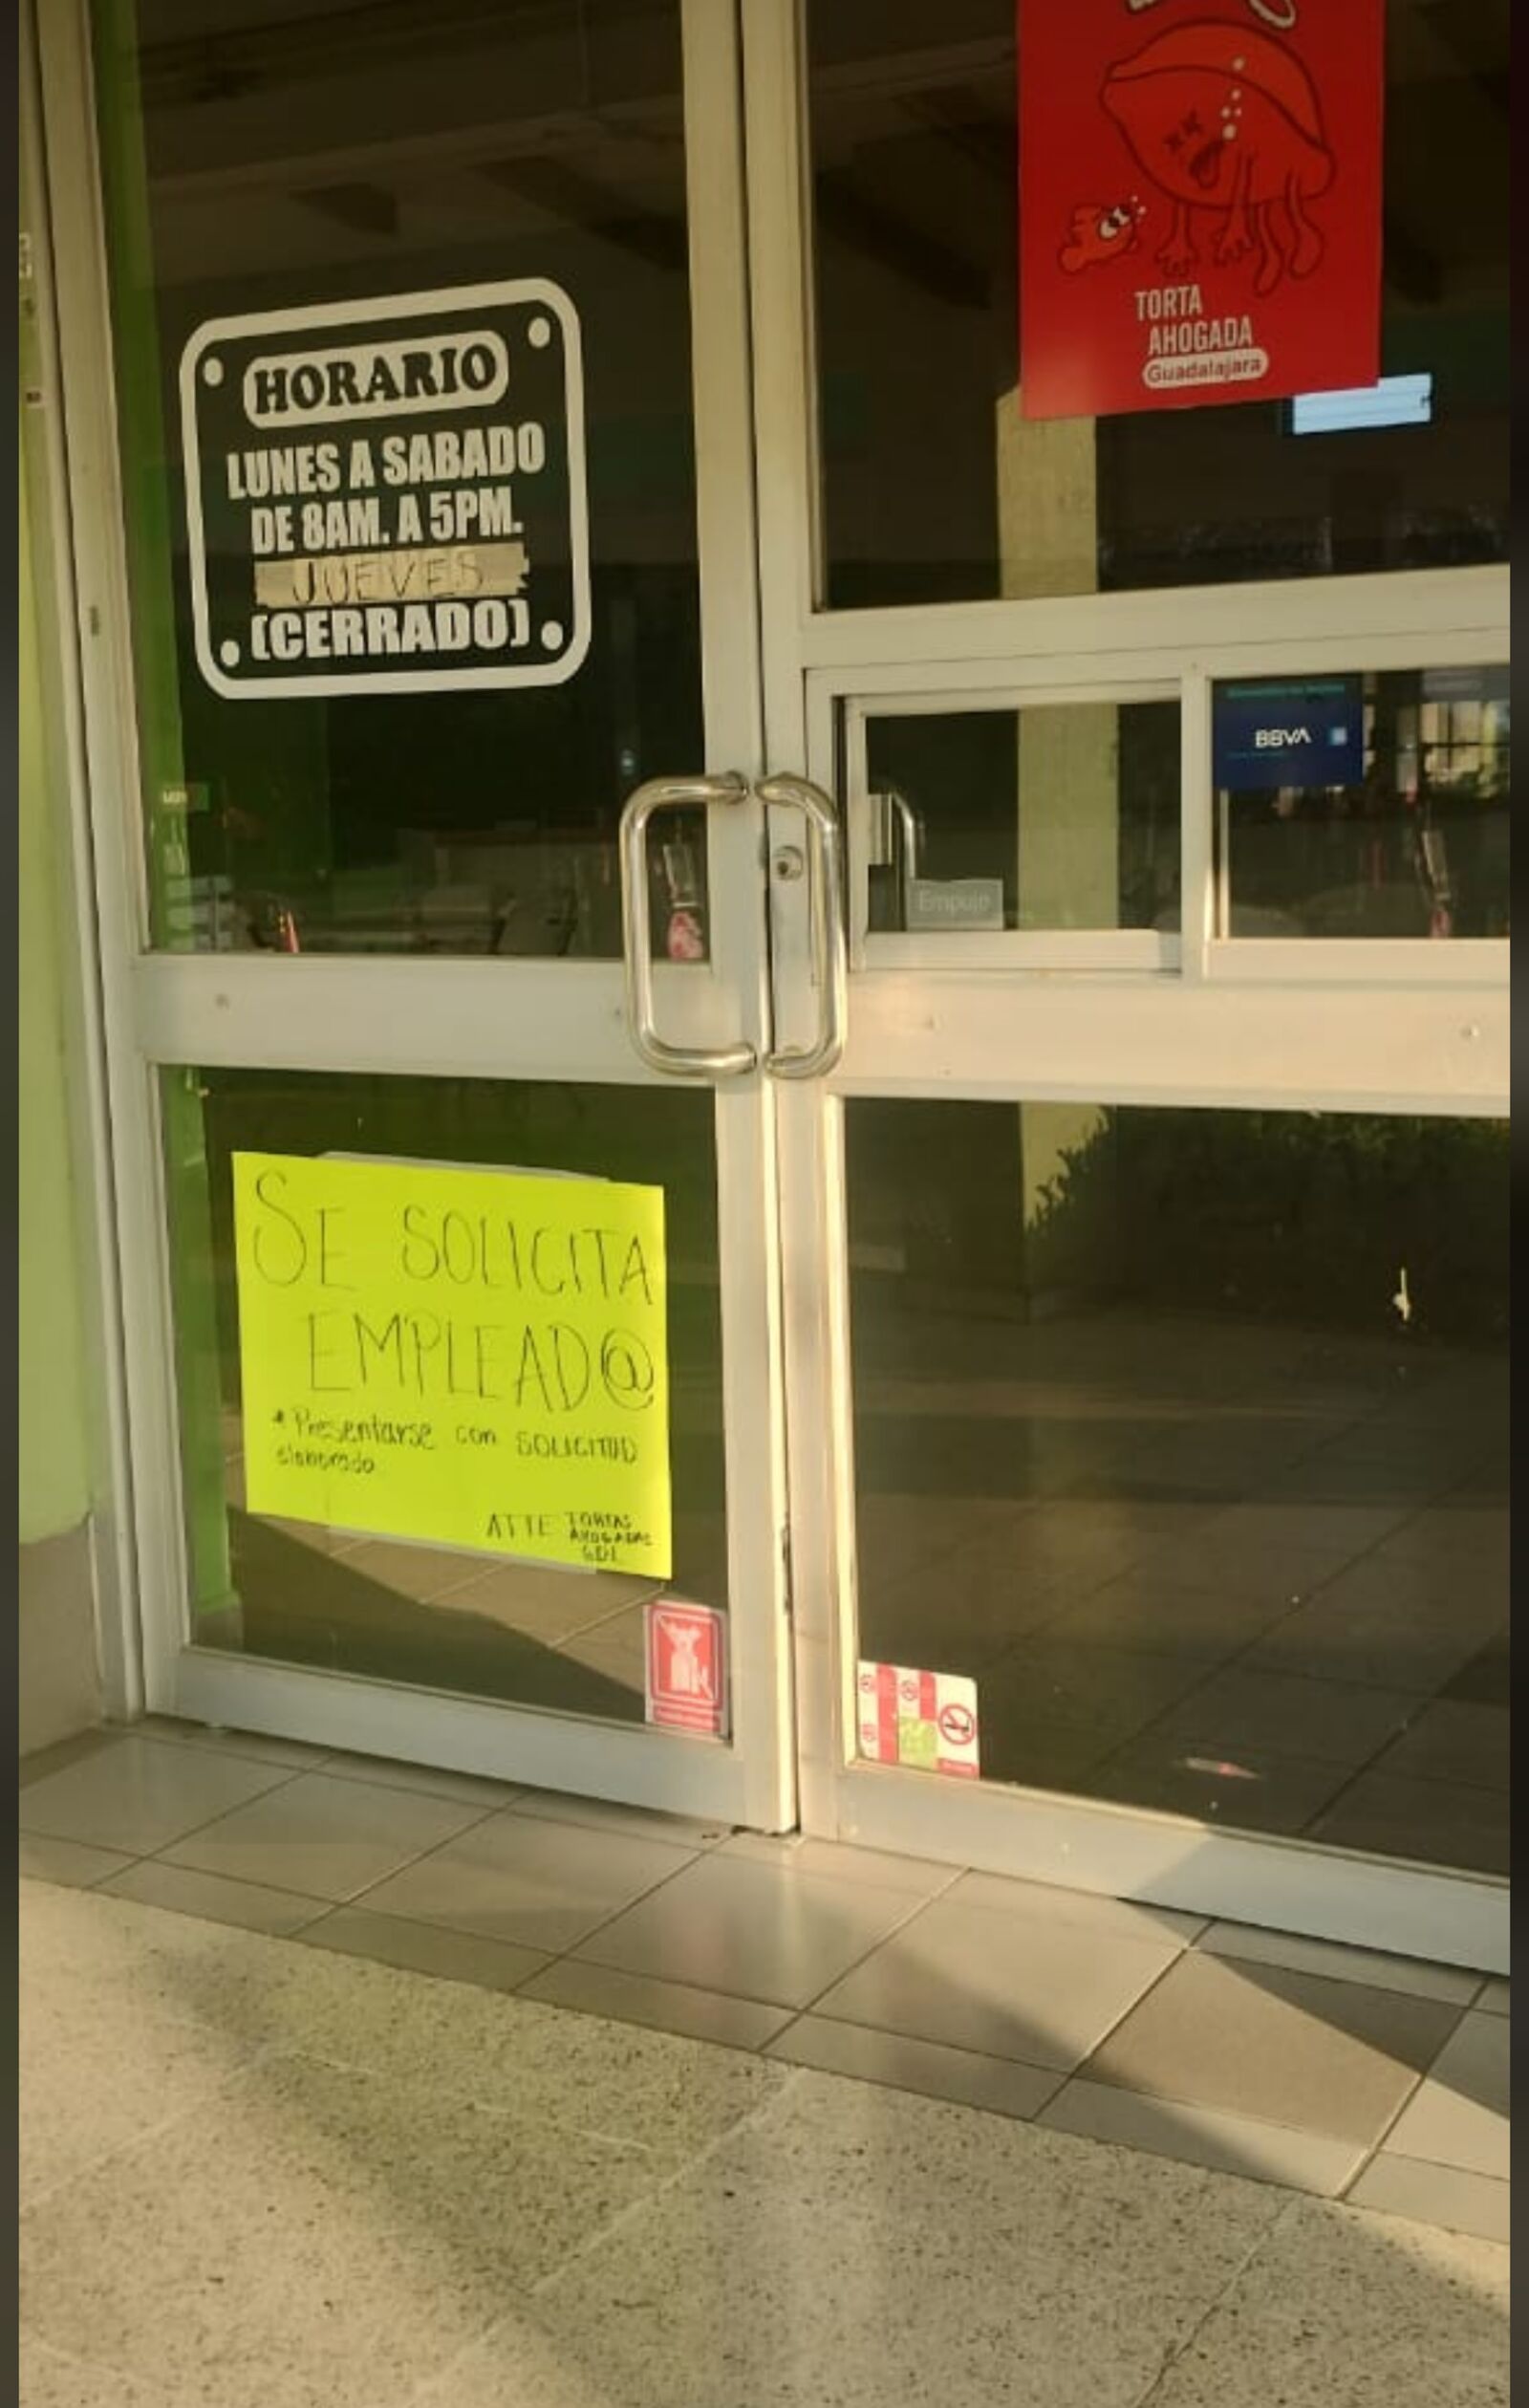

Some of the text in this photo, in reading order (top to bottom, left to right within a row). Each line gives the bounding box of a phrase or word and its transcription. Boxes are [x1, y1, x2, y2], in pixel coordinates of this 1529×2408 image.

[1134, 284, 1203, 321] TORTA
[1148, 315, 1253, 356] AHOGADA
[253, 342, 497, 415] HORARIO
[1148, 358, 1261, 382] Guadalajara
[226, 422, 546, 500] LUNES A SABADO
[250, 486, 525, 555] DE 8AM. A 5PM.
[292, 551, 484, 604] JUEVES
[1254, 727, 1312, 748] BBVA
[252, 1168, 655, 1306] SE SOLICITA
[306, 1309, 657, 1414] EMPLEAD@
[455, 1425, 497, 1445] con
[486, 1512, 558, 1539] ATTE
